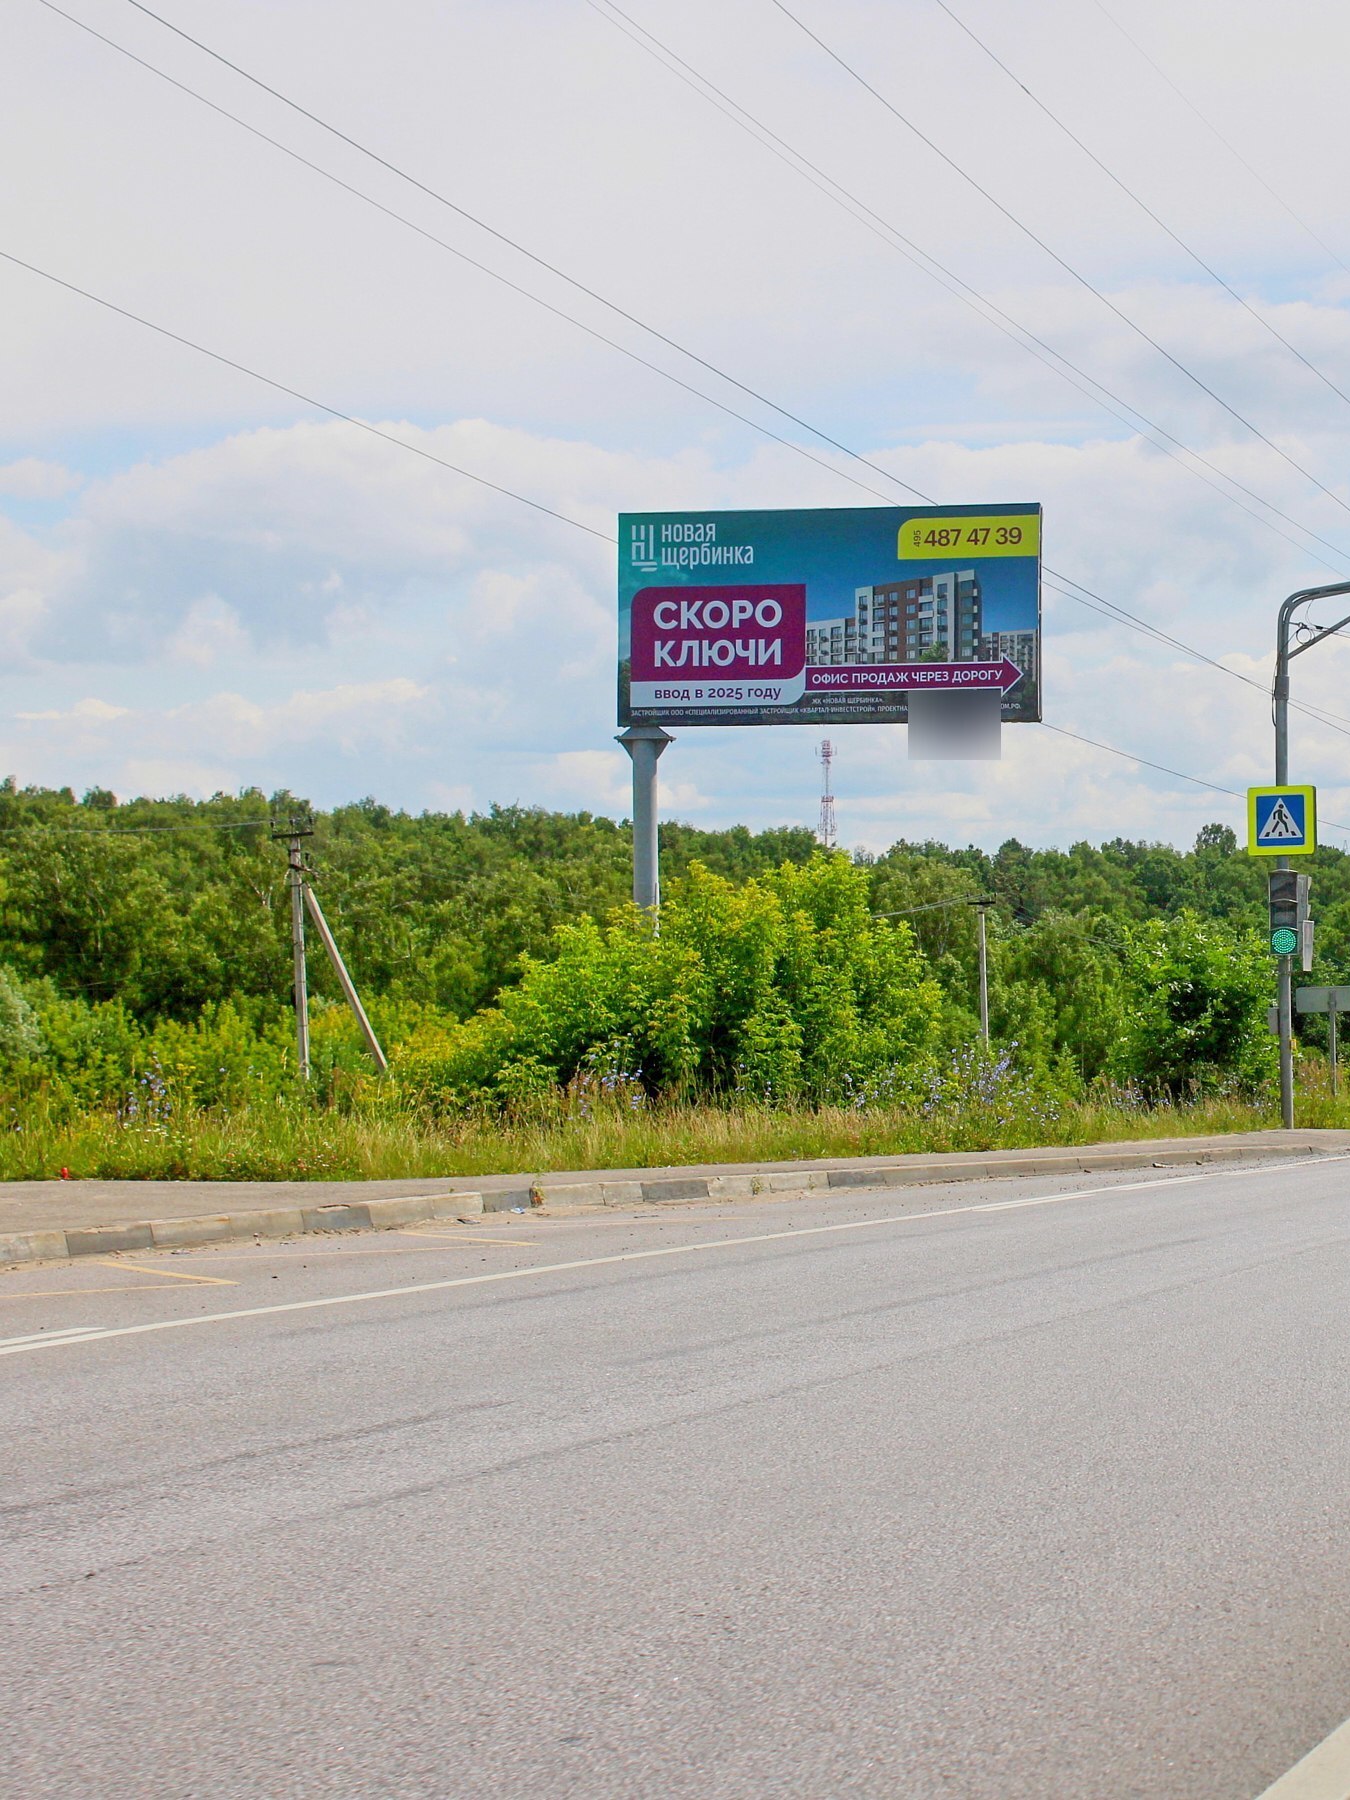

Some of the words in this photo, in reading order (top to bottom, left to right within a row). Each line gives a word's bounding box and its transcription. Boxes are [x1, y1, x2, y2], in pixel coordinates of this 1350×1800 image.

[661, 523, 717, 542] новая
[913, 530, 921, 547] 495
[924, 529, 962, 547] 487
[966, 528, 991, 546] 47
[995, 527, 1022, 545] 39
[661, 543, 754, 570] щербинка
[653, 599, 783, 630] СКОРО
[654, 639, 782, 667] КЛЮЧИ
[812, 673, 848, 684] ОФИС
[852, 672, 909, 685] ПРОДАЖ
[912, 671, 949, 683] ЧЕРЕЗ
[952, 670, 1003, 683] ДОРОГУ
[708, 687, 743, 700] 2025
[747, 687, 782, 700] году
